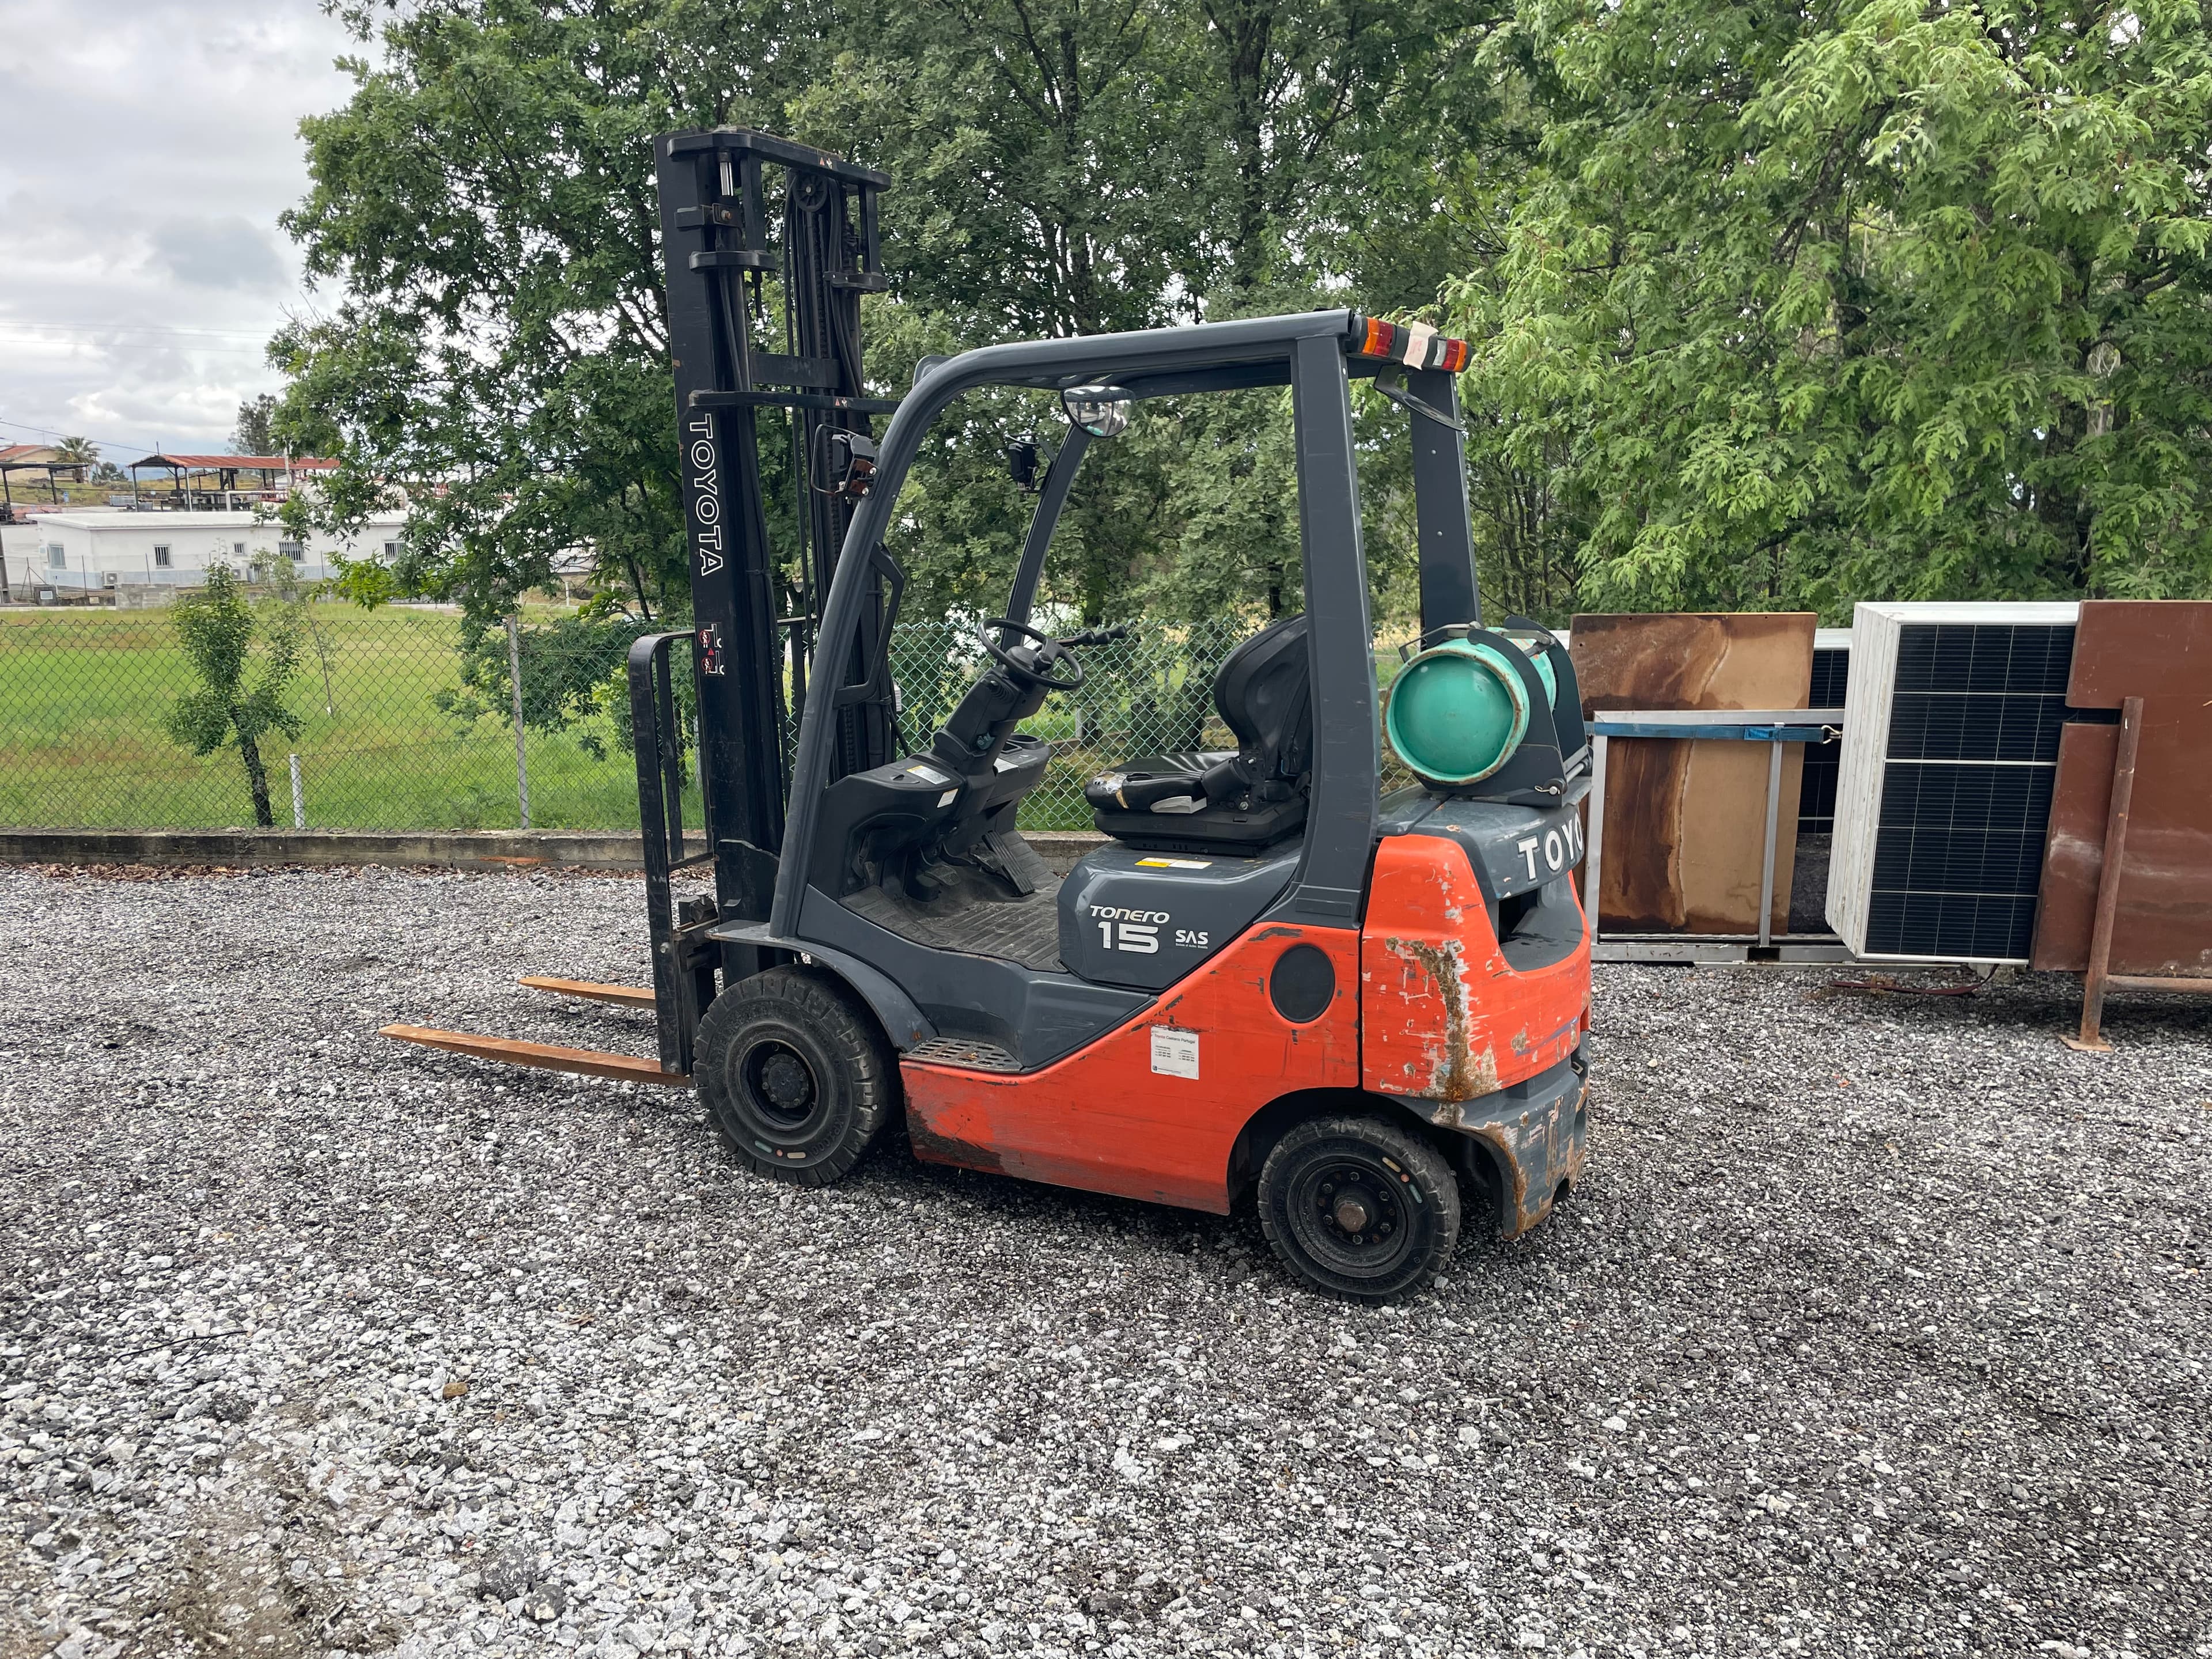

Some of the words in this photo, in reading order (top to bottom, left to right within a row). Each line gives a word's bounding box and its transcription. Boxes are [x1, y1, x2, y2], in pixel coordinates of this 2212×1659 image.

[690, 413, 724, 577] TOYOTA
[1090, 904, 1171, 924] TONERO
[1097, 921, 1160, 954] 15
[1175, 929, 1209, 945] SAS
